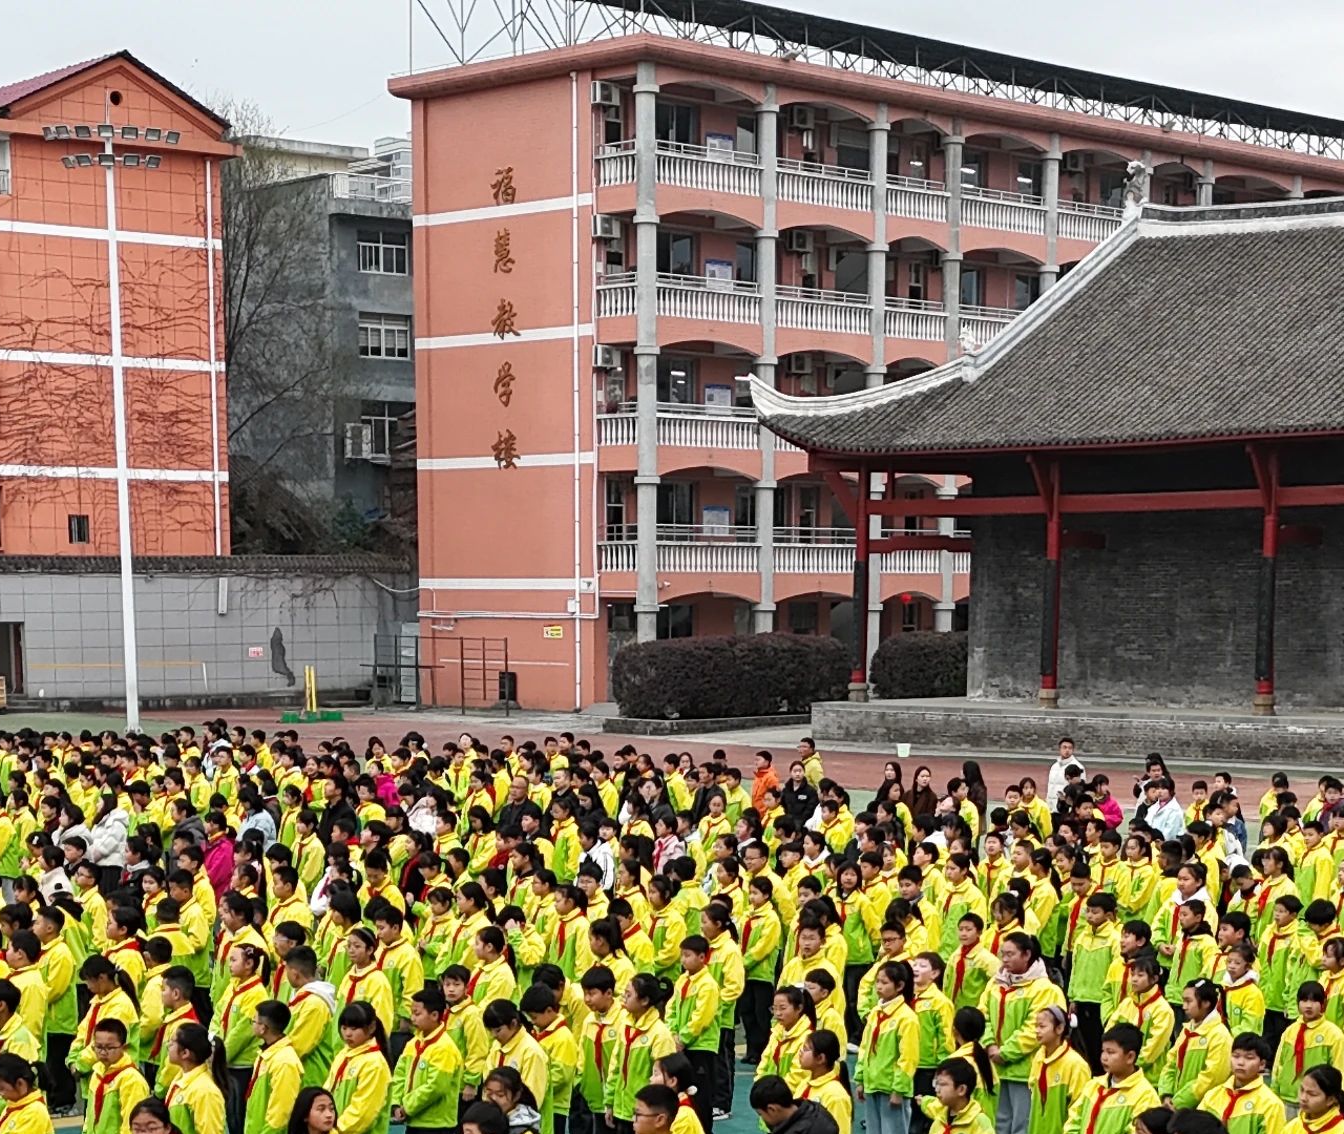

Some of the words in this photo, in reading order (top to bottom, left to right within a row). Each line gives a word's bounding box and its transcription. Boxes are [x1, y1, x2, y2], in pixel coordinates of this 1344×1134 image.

[489, 166, 521, 471] 福慧教学楼
